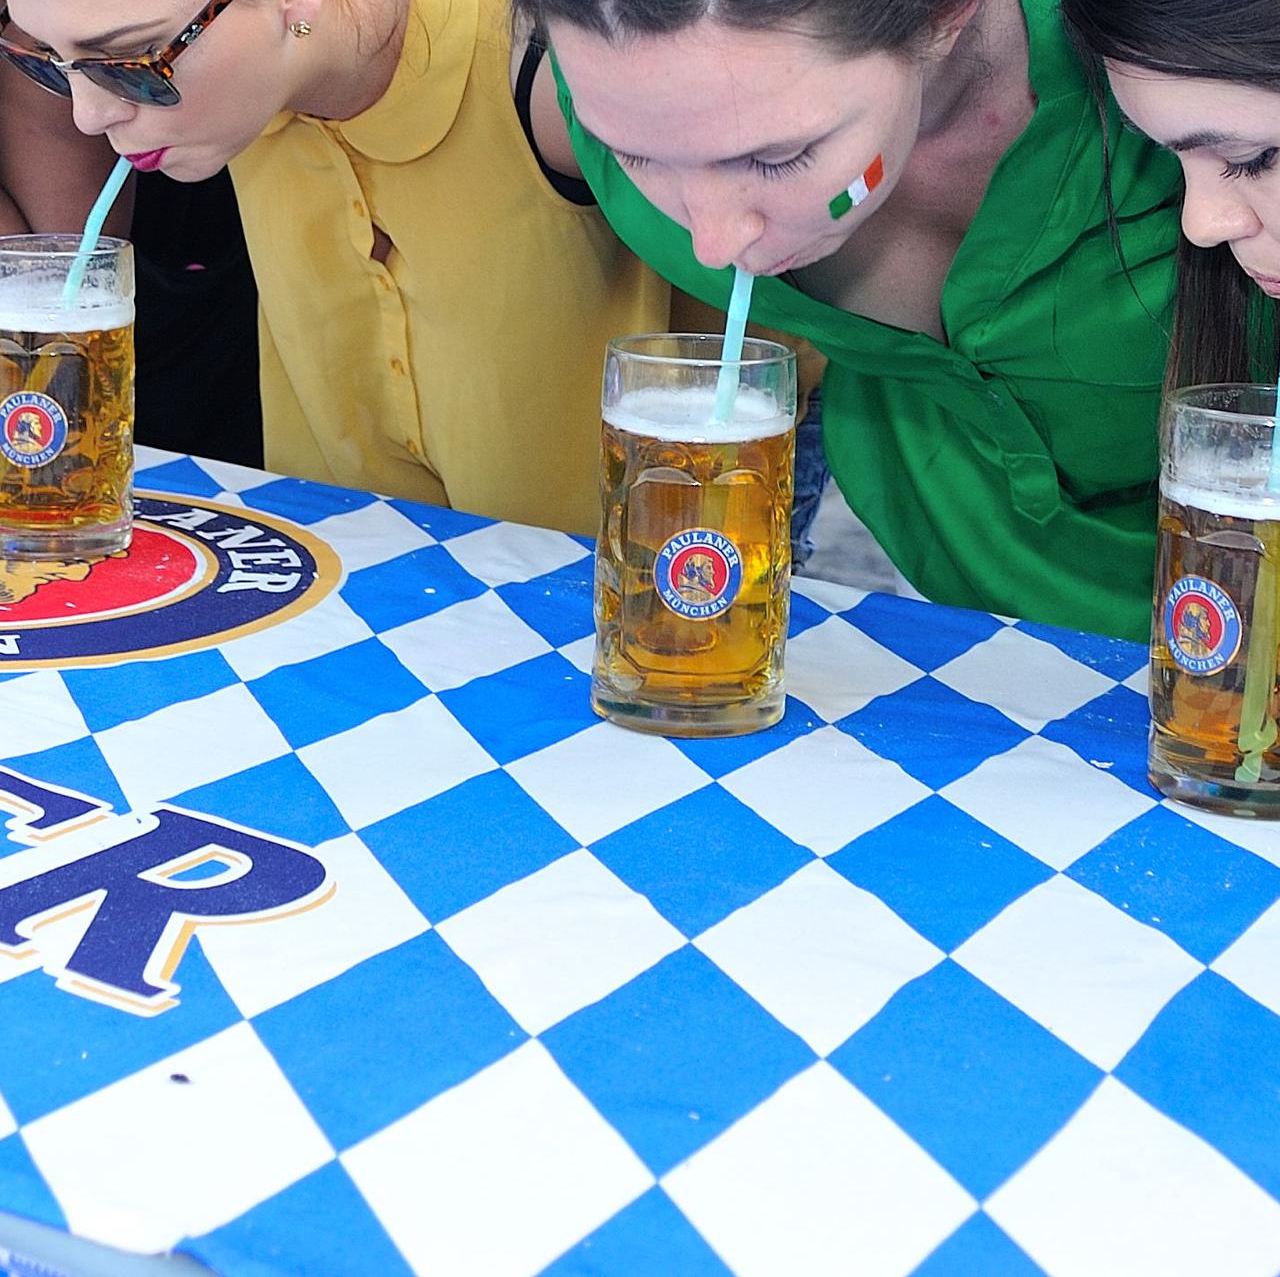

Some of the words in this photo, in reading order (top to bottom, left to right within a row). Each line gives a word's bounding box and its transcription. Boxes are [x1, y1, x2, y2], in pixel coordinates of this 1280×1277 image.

[0, 394, 62, 424] PAULANER
[662, 532, 739, 569] PAULANER
[1168, 579, 1236, 623] PAULANER
